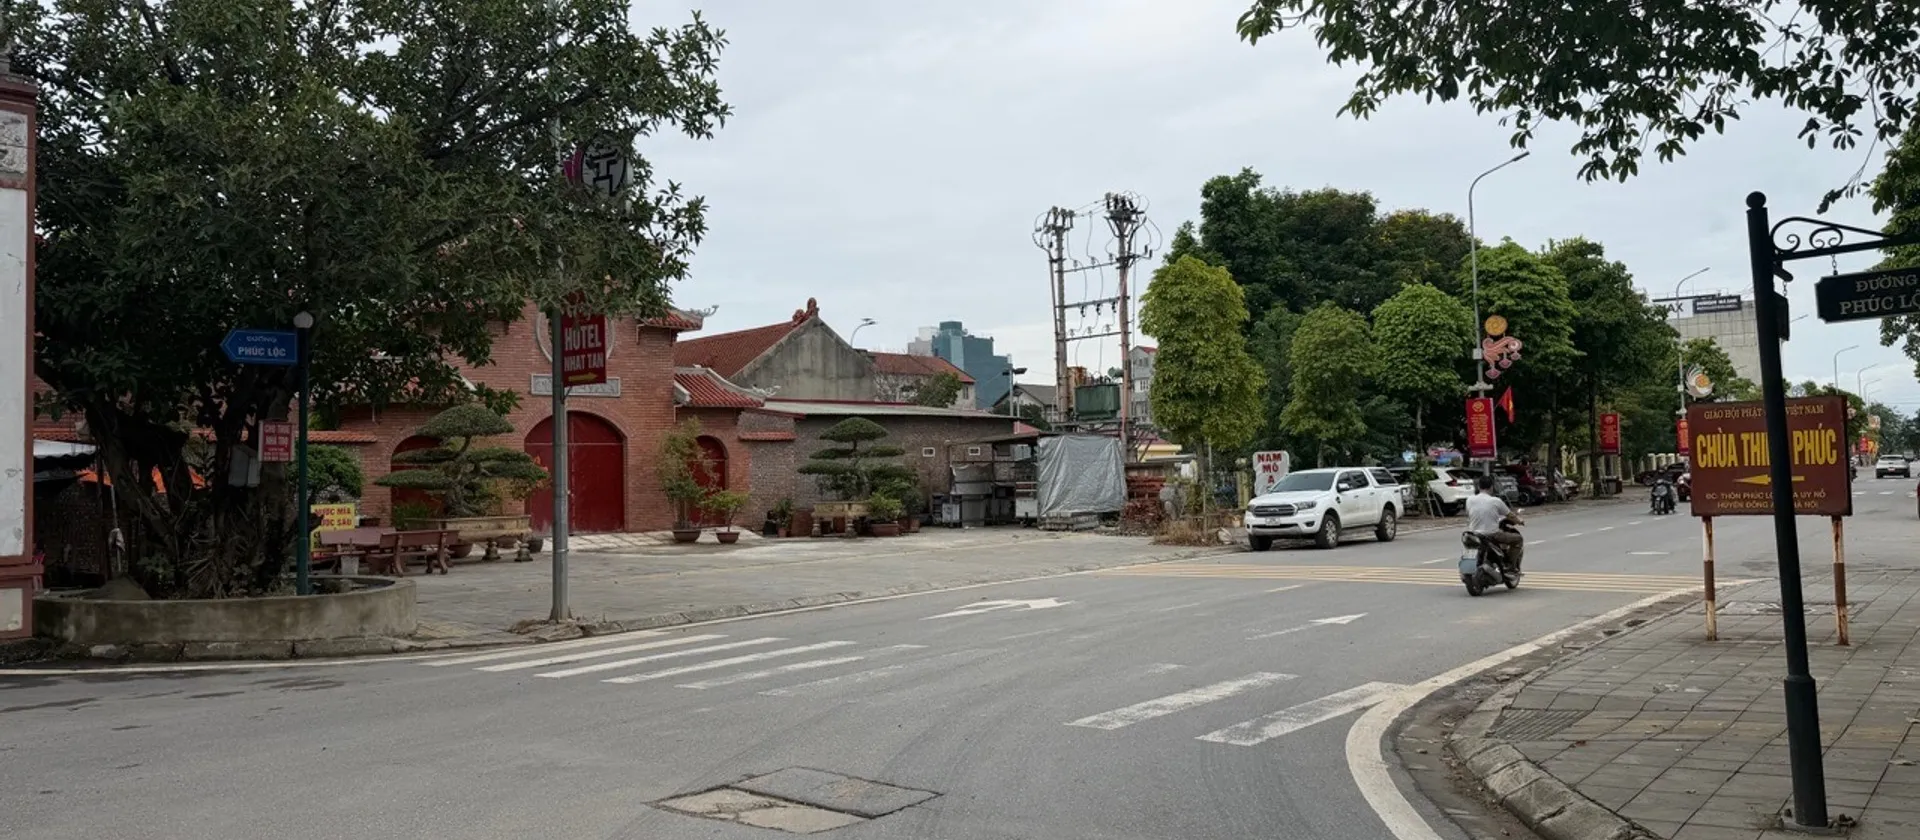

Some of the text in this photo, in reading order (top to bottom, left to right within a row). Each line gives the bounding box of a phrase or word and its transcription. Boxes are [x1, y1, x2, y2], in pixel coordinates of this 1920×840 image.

[1855, 274, 1917, 292] ĐƯỜNG
[1840, 294, 1894, 315] PHÚC
[564, 324, 602, 351] HOTEL
[238, 345, 287, 358] PHÚC LỘC
[1704, 407, 1724, 420] GIÁO
[1725, 406, 1740, 419] HỘI
[1741, 406, 1763, 418] PHẬT
[1804, 404, 1825, 415] NAM
[1696, 426, 1739, 469] CHÙA
[1741, 431, 1770, 467] THI
[1792, 423, 1837, 466] PHÚC
[1257, 453, 1282, 462] NAM
[1262, 463, 1279, 473] MÔ
[1267, 475, 1275, 484] A
